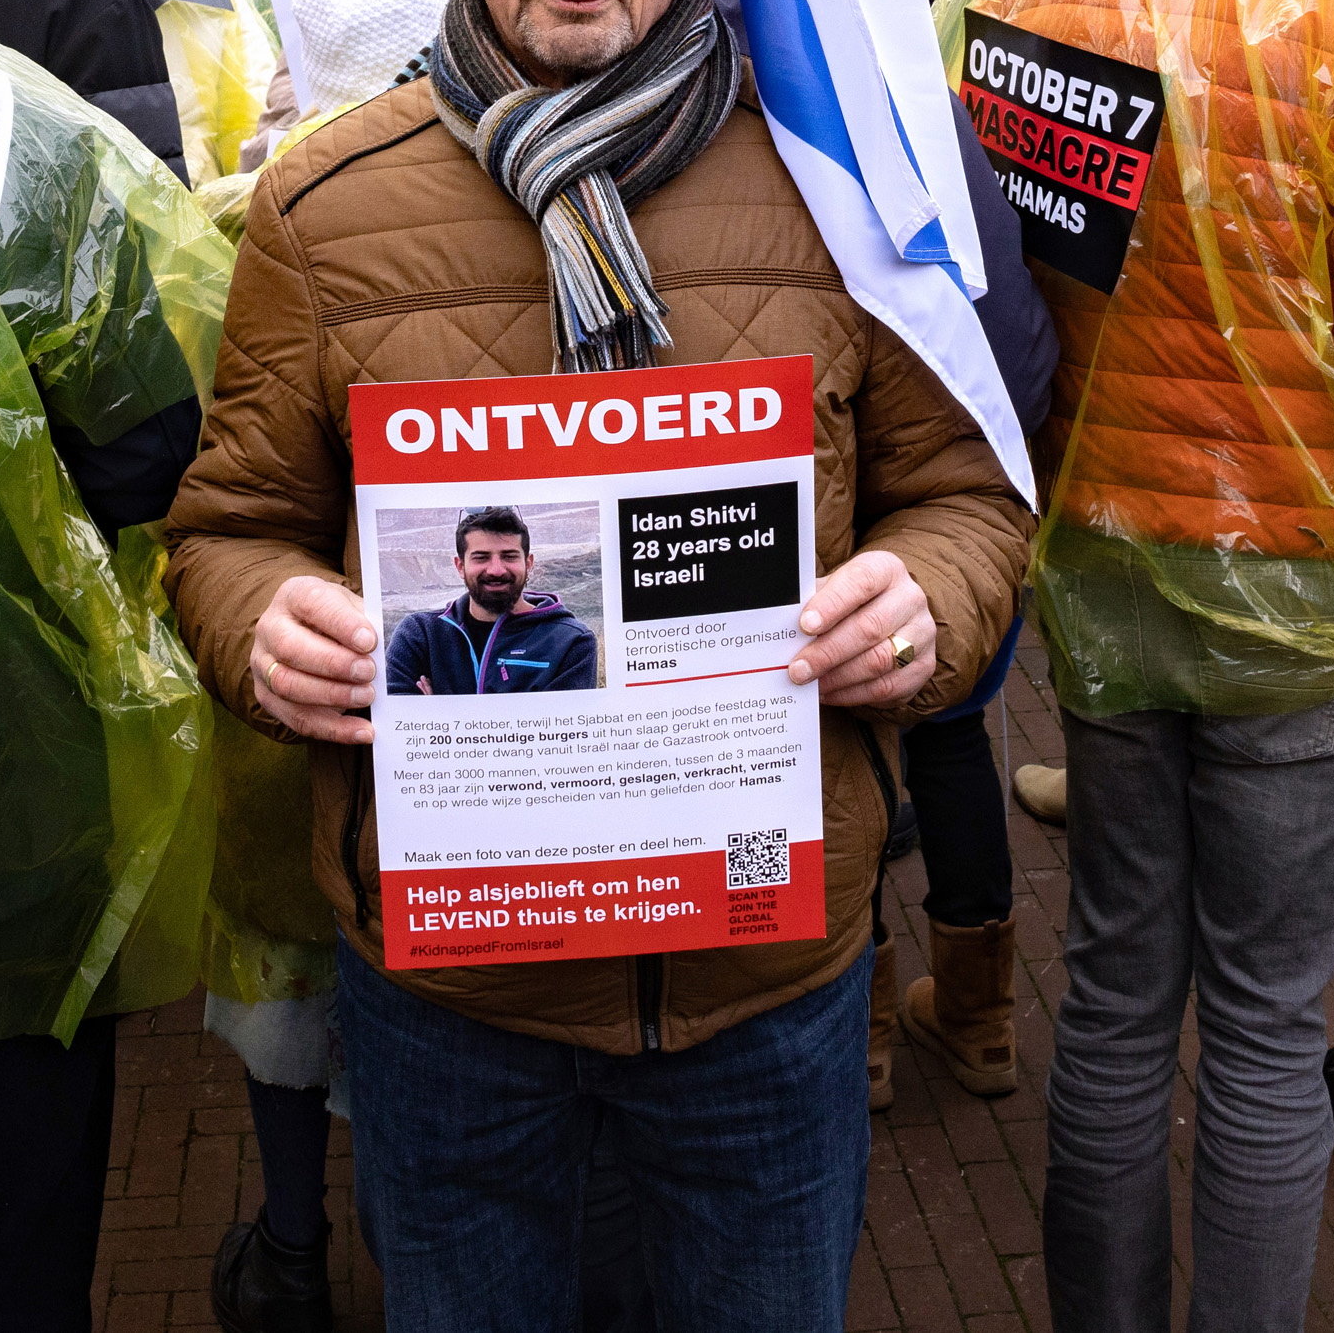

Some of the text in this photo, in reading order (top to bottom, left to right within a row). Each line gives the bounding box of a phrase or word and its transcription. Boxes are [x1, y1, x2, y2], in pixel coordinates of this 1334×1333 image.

[969, 38, 1155, 141] OCTOBER 7
[966, 90, 1140, 200] MASSACRE
[1007, 171, 1087, 234] HAMAS
[385, 386, 783, 455] ONTVOERD
[632, 502, 756, 532] Idan Shitvi
[632, 527, 775, 561] 28 years old
[634, 563, 705, 587] Israeli
[625, 622, 727, 641] Ontvoerd door
[626, 628, 797, 656] terroristische organisatie
[626, 658, 677, 672] Hamas
[395, 694, 797, 733] Zaterdag 7 oktober, terwijl het Sjabbat en een joodse feestdag was,
[406, 709, 788, 746] zijn 200 onschuldige burgers uit hun slaap gerukt en met bruut
[406, 724, 788, 761] geweld onder dwang vanuit Israël naar de Gazastrook ontvoerd.
[394, 743, 802, 780] Meer dan 3000 mannen, vrouwen en kinderen, tussen de 3 maanden
[400, 757, 797, 796] en 83 jaar zijn verwond, vermoord, geslagen, verkracht, vermist
[413, 774, 785, 810] en op wrede wijze gescheiden van hun geliefden door Hamas.
[404, 836, 706, 863] Maak een foto van deze poster en deel hem.
[407, 875, 680, 908] Help alsjeblieft om hen
[728, 890, 776, 902] SCAN TO
[728, 900, 777, 913] JOIN THE
[409, 900, 702, 932] LEVEND thuis te krijgen.
[729, 913, 774, 924] GLOBAL
[729, 923, 779, 935] EFFORTS
[410, 938, 564, 957] #KidnappedFromIsrael
